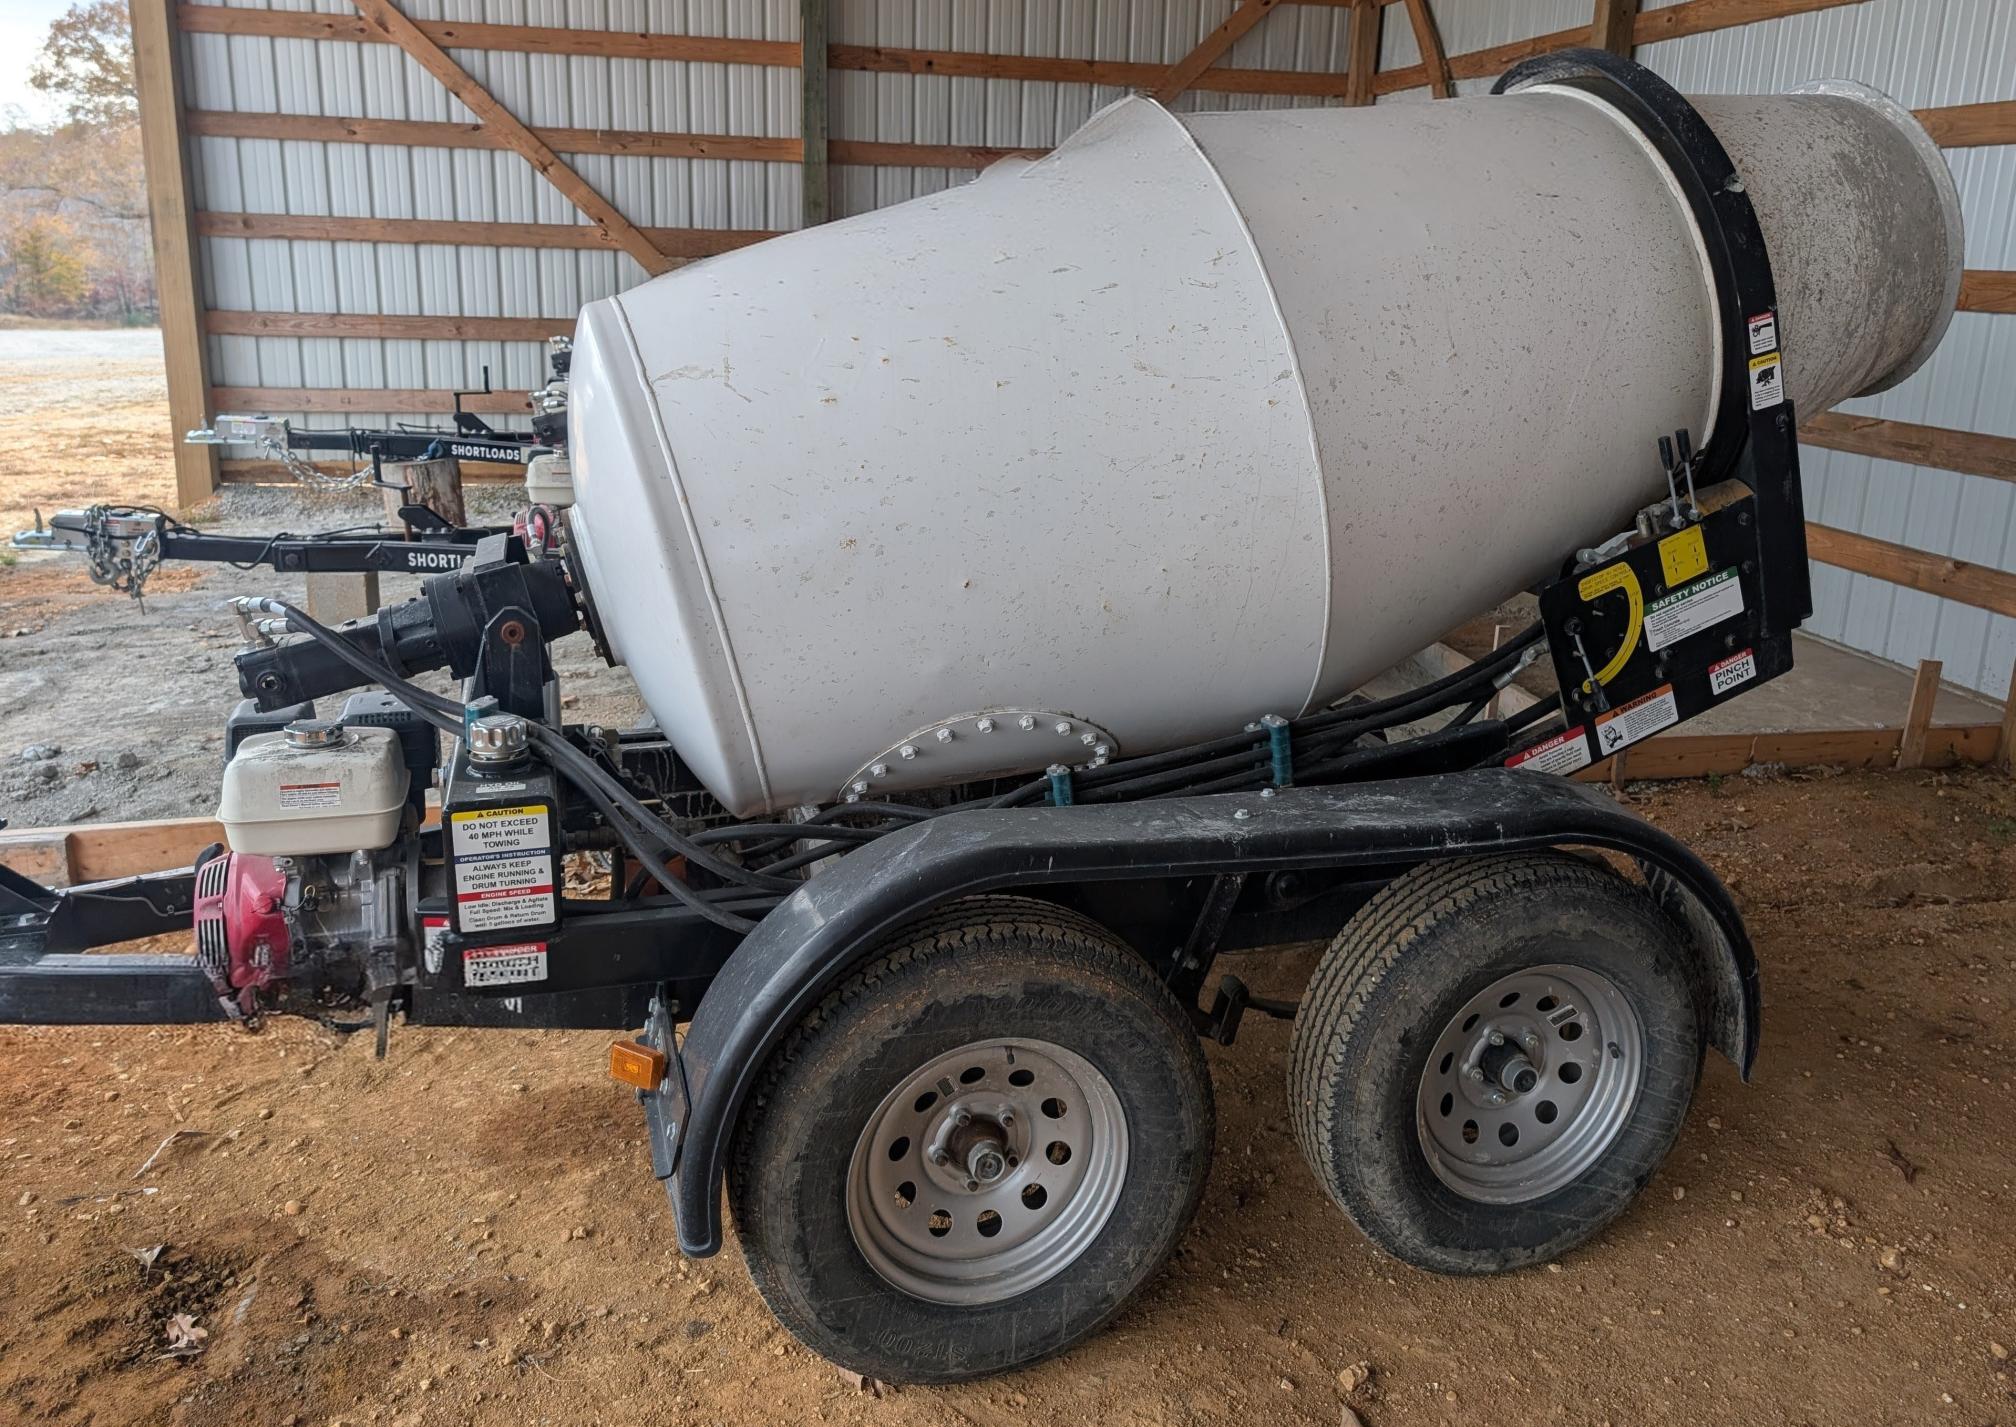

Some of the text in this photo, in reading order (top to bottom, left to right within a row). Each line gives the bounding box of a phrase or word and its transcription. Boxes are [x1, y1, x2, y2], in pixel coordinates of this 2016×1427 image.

[451, 444, 520, 460] SHORTLOADS
[408, 552, 474, 568] SHORTL
[1652, 589, 1690, 611] SAFETY
[1692, 571, 1729, 593] NOTICE
[1720, 651, 1747, 667] DANGER
[1715, 659, 1750, 681] PINCH
[1718, 668, 1751, 689] POINT
[1620, 692, 1657, 713] WARNING
[1532, 736, 1565, 755] DANGER
[486, 808, 524, 817] CAUTION
[462, 818, 538, 831] DO NOT EXCEED
[469, 828, 534, 840] 40 MPH WHILE
[483, 839, 520, 848] TOWING
[460, 850, 546, 862] OPERATOR'S INSTRUCTION
[473, 860, 532, 872] ALWAYS KEEP
[463, 872, 496, 882] ENGINE
[498, 869, 536, 878] RUNNING
[472, 877, 537, 890] DRUM TURNING
[481, 888, 531, 898] ENGINE SPEED
[492, 899, 520, 907] Discharge
